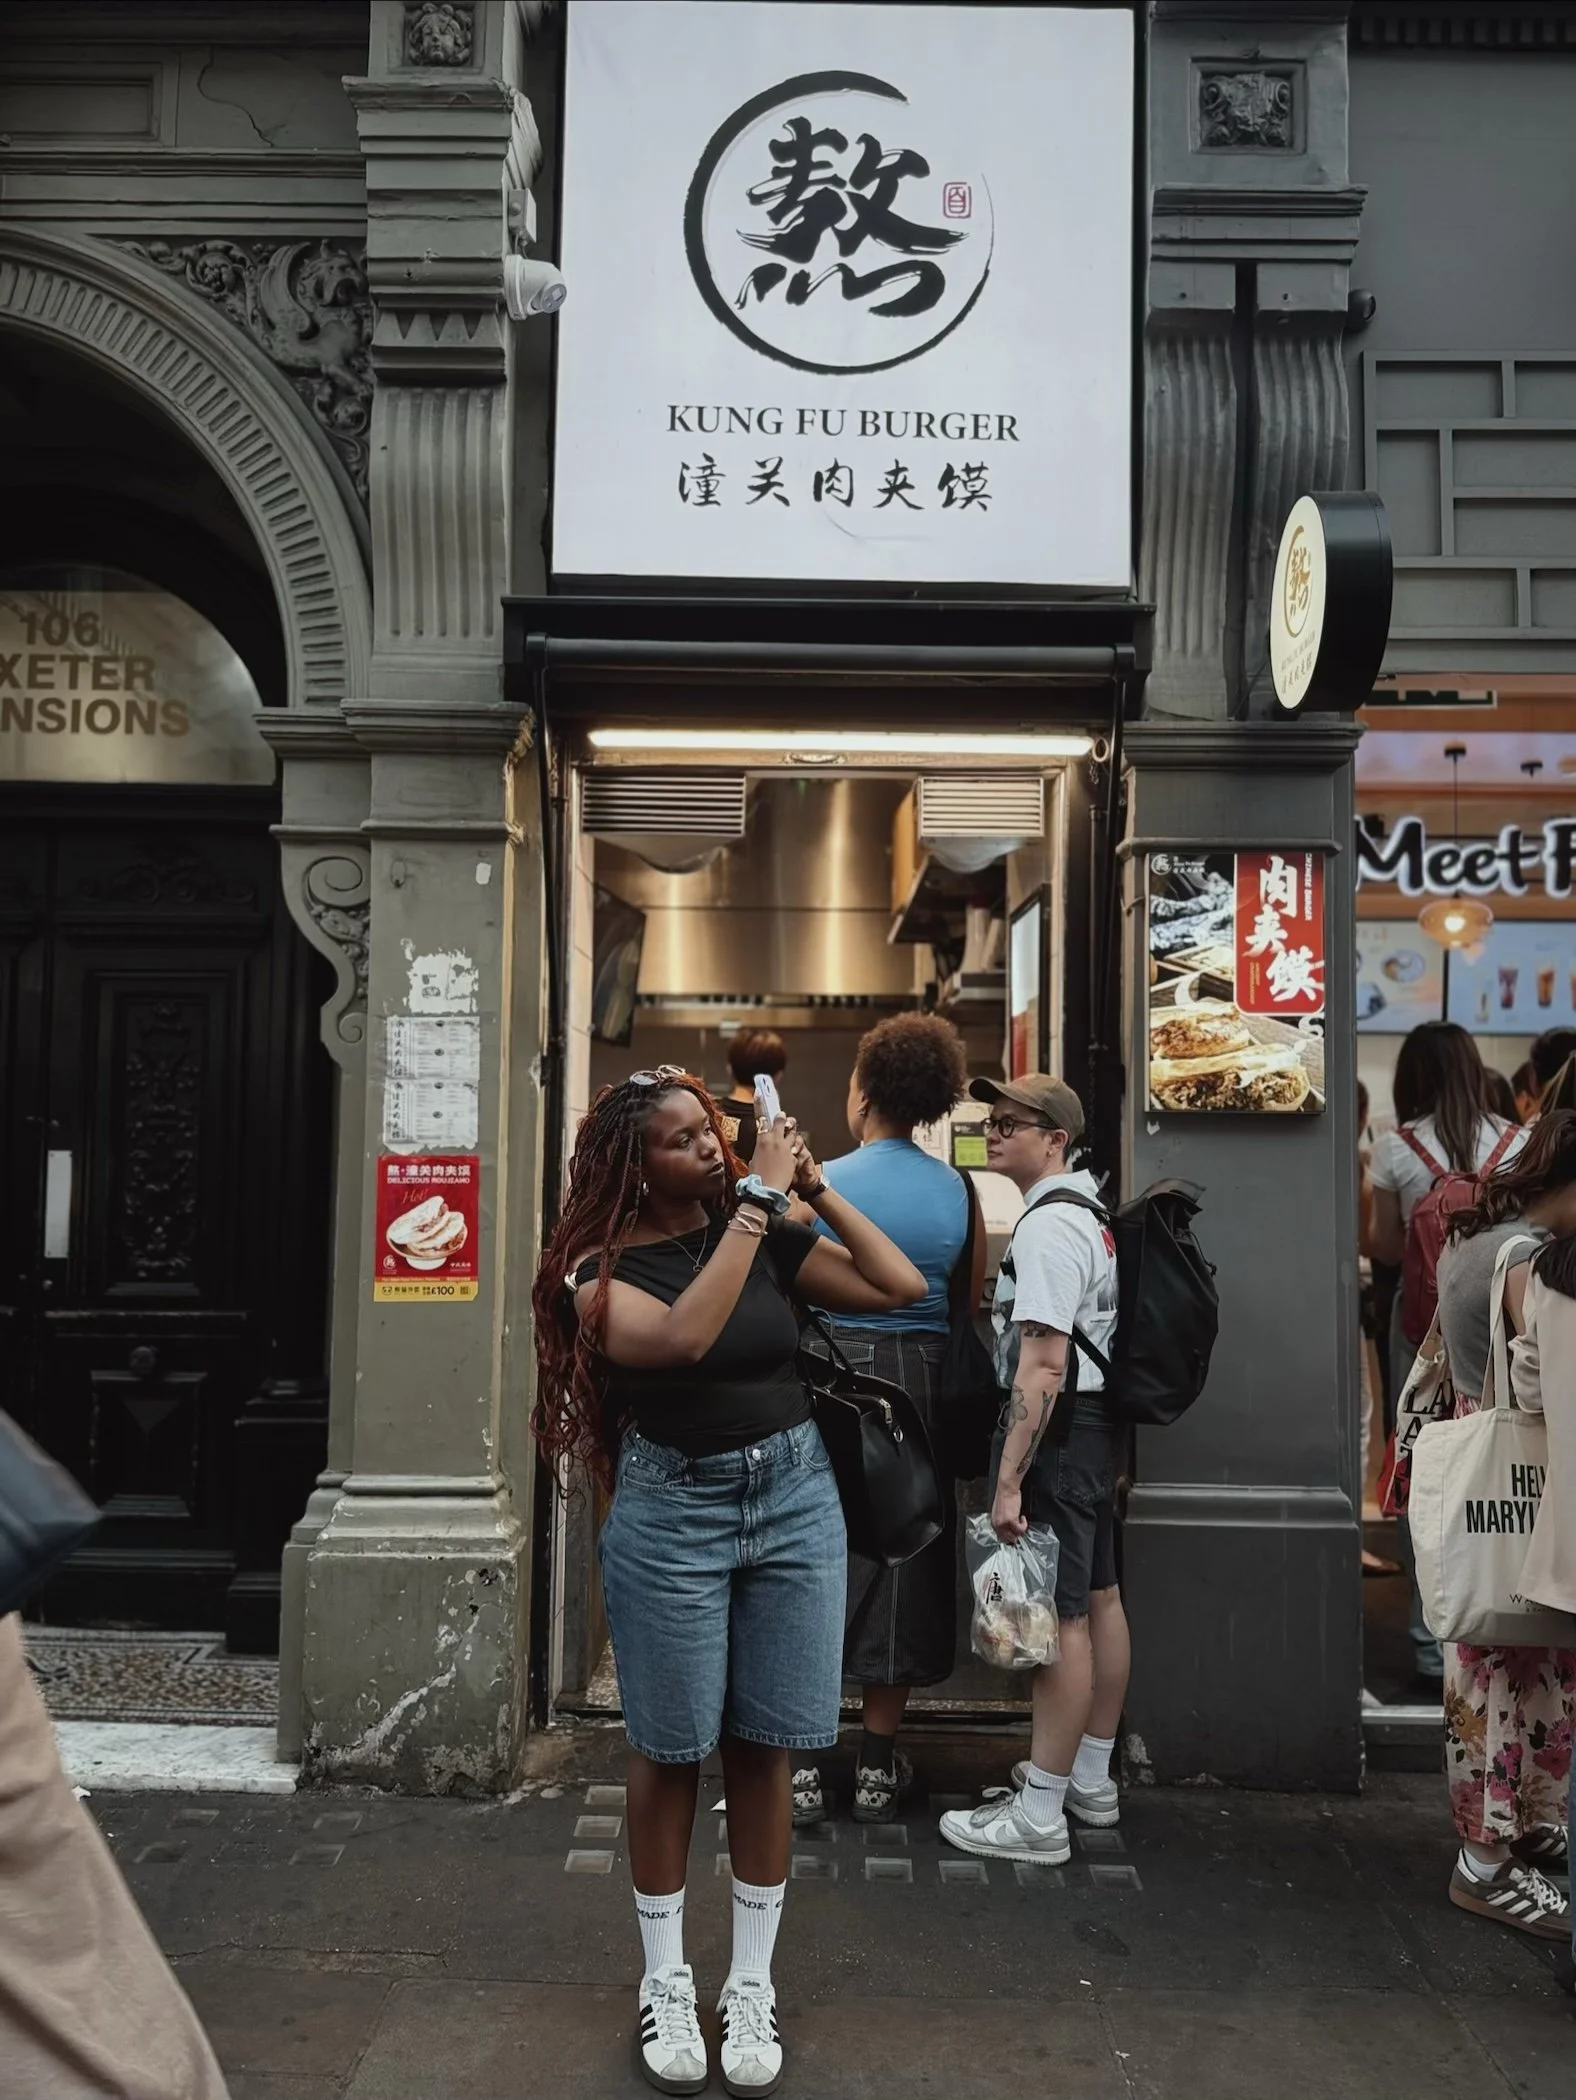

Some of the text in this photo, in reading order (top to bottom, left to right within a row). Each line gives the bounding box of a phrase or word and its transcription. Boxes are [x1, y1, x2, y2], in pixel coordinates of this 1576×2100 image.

[667, 404, 1020, 442] KUNG FU BURGER
[678, 452, 993, 512] 潼关肉夹馍
[20, 610, 100, 647] 106
[0, 697, 190, 738] NSIONS
[1355, 817, 1540, 894] Meet
[1242, 854, 1325, 1002] 肉夹馍
[387, 1176, 430, 1184] DELICIOUS
[636, 1908, 670, 1920] MADE
[733, 1893, 767, 1910] MADE
